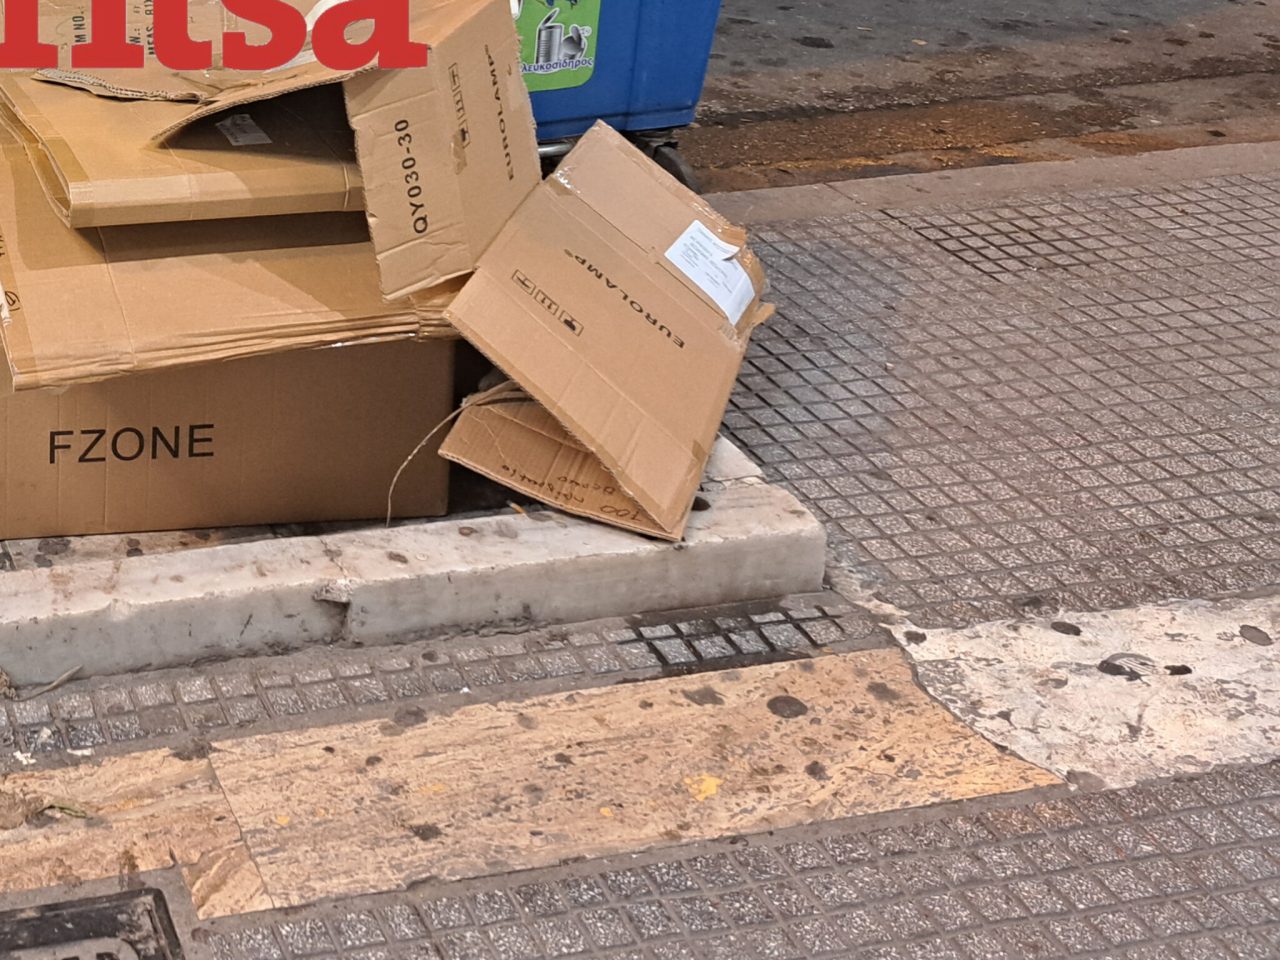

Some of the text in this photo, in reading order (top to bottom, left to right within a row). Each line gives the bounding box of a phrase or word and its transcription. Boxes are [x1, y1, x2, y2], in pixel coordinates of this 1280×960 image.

[394, 119, 429, 234] QY030-30
[573, 254, 686, 349] EUROLAMP
[49, 424, 215, 464] FZONE
